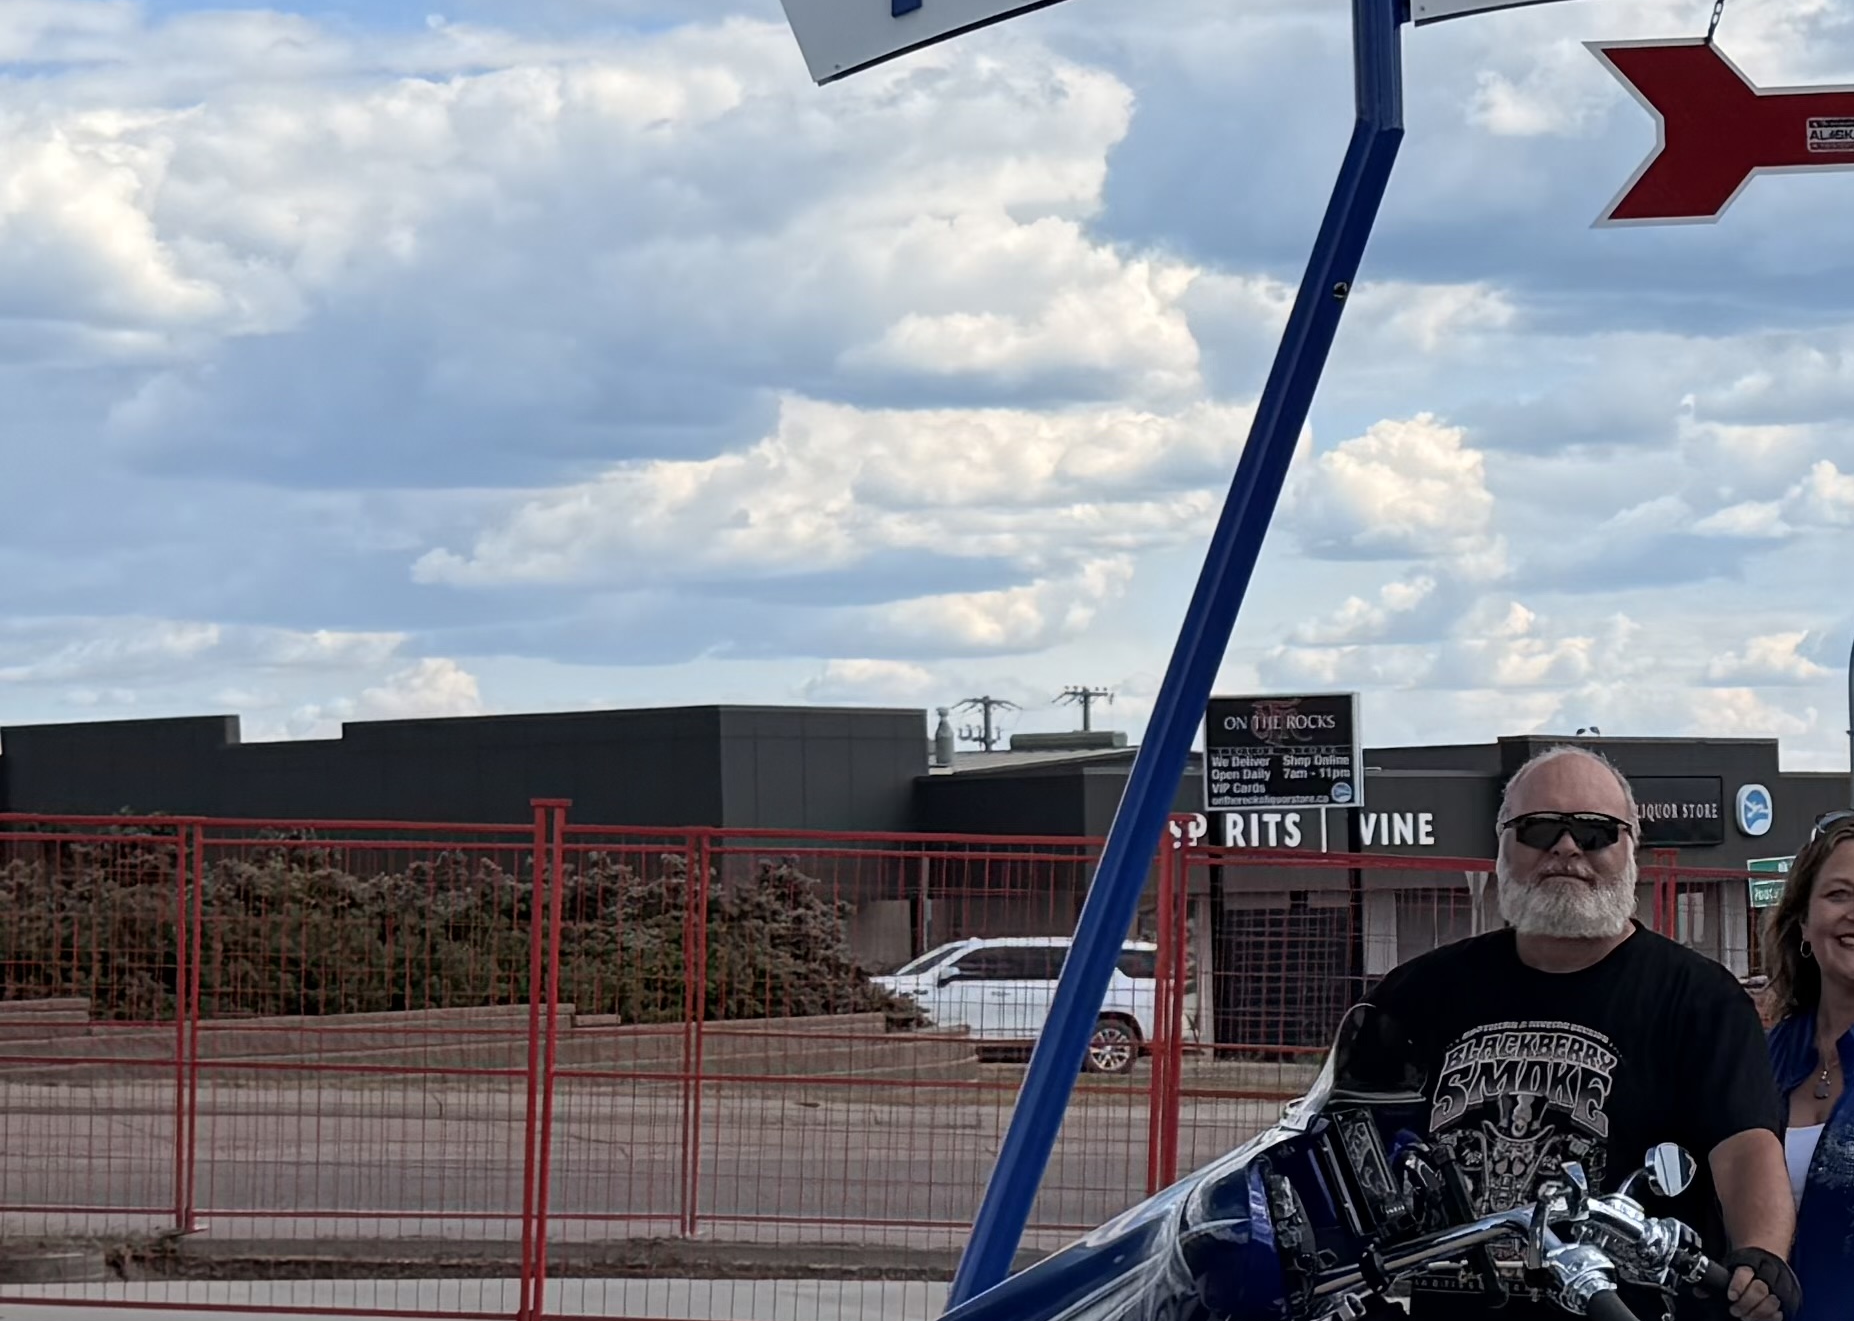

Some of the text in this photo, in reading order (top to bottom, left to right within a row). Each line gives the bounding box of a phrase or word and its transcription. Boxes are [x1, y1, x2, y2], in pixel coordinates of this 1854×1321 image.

[1224, 714, 1336, 730] ON THE ROCKS
[1212, 757, 1271, 767] We Deliver
[1282, 754, 1350, 768] Shop Online
[1211, 768, 1271, 782] Open Daily
[1283, 768, 1308, 779] 7am
[1320, 767, 1351, 781] 11pm
[1212, 782, 1266, 794] VIP Cards
[1682, 802, 1719, 819] STORE
[1441, 1031, 1619, 1078] BLACKBERRY
[1428, 1058, 1613, 1138] SMOKE
